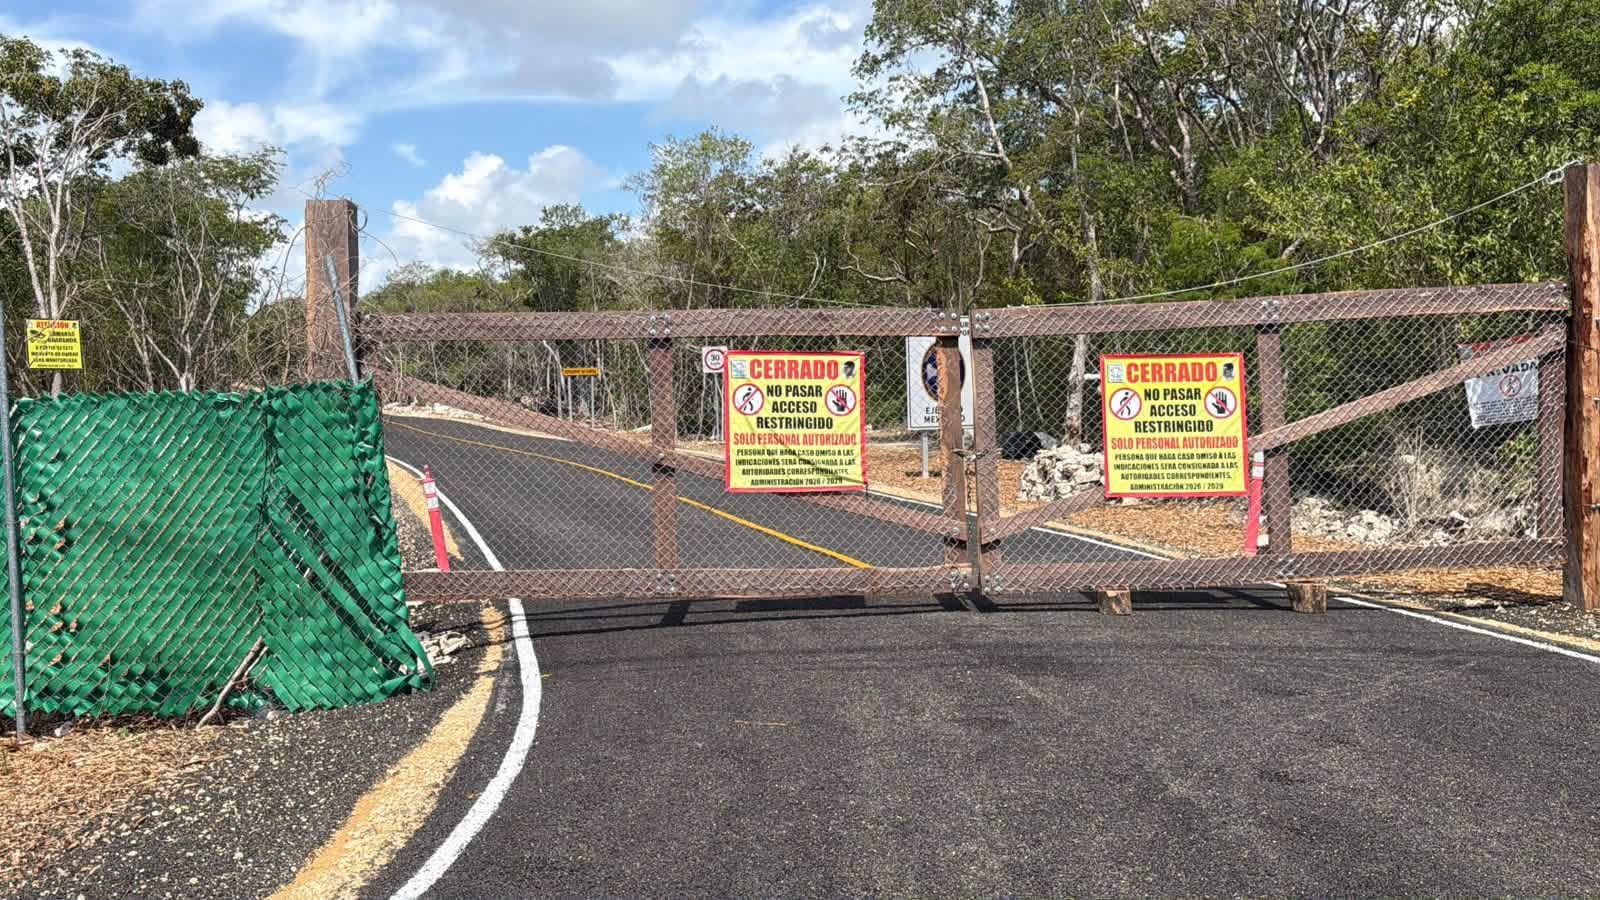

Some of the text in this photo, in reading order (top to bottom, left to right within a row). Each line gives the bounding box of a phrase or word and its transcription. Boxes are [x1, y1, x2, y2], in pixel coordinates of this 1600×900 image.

[749, 359, 839, 380] CERRADO
[1126, 362, 1218, 383] CERRADO
[766, 385, 822, 398] NO PASAR
[1144, 388, 1202, 400] NO PASAR
[771, 401, 817, 414] ACCESO
[1150, 404, 1196, 416] ACCESO
[756, 417, 834, 430] RESTRINGIDO
[1134, 420, 1214, 432] RESTRINGIDO
[733, 433, 857, 446] SOLO PERSONAL AUTORIZADO
[1111, 436, 1238, 450] SOLO PERSONAL AUTORIZADO
[735, 458, 780, 466] INDICACIONES
[844, 458, 856, 466] LAS
[1196, 452, 1218, 460] OMISO
[1178, 462, 1220, 470] CONSIGNADA
[1226, 461, 1238, 469] LAS
[1121, 472, 1165, 480] AUTORIDADES
[1207, 482, 1224, 490] 2029
